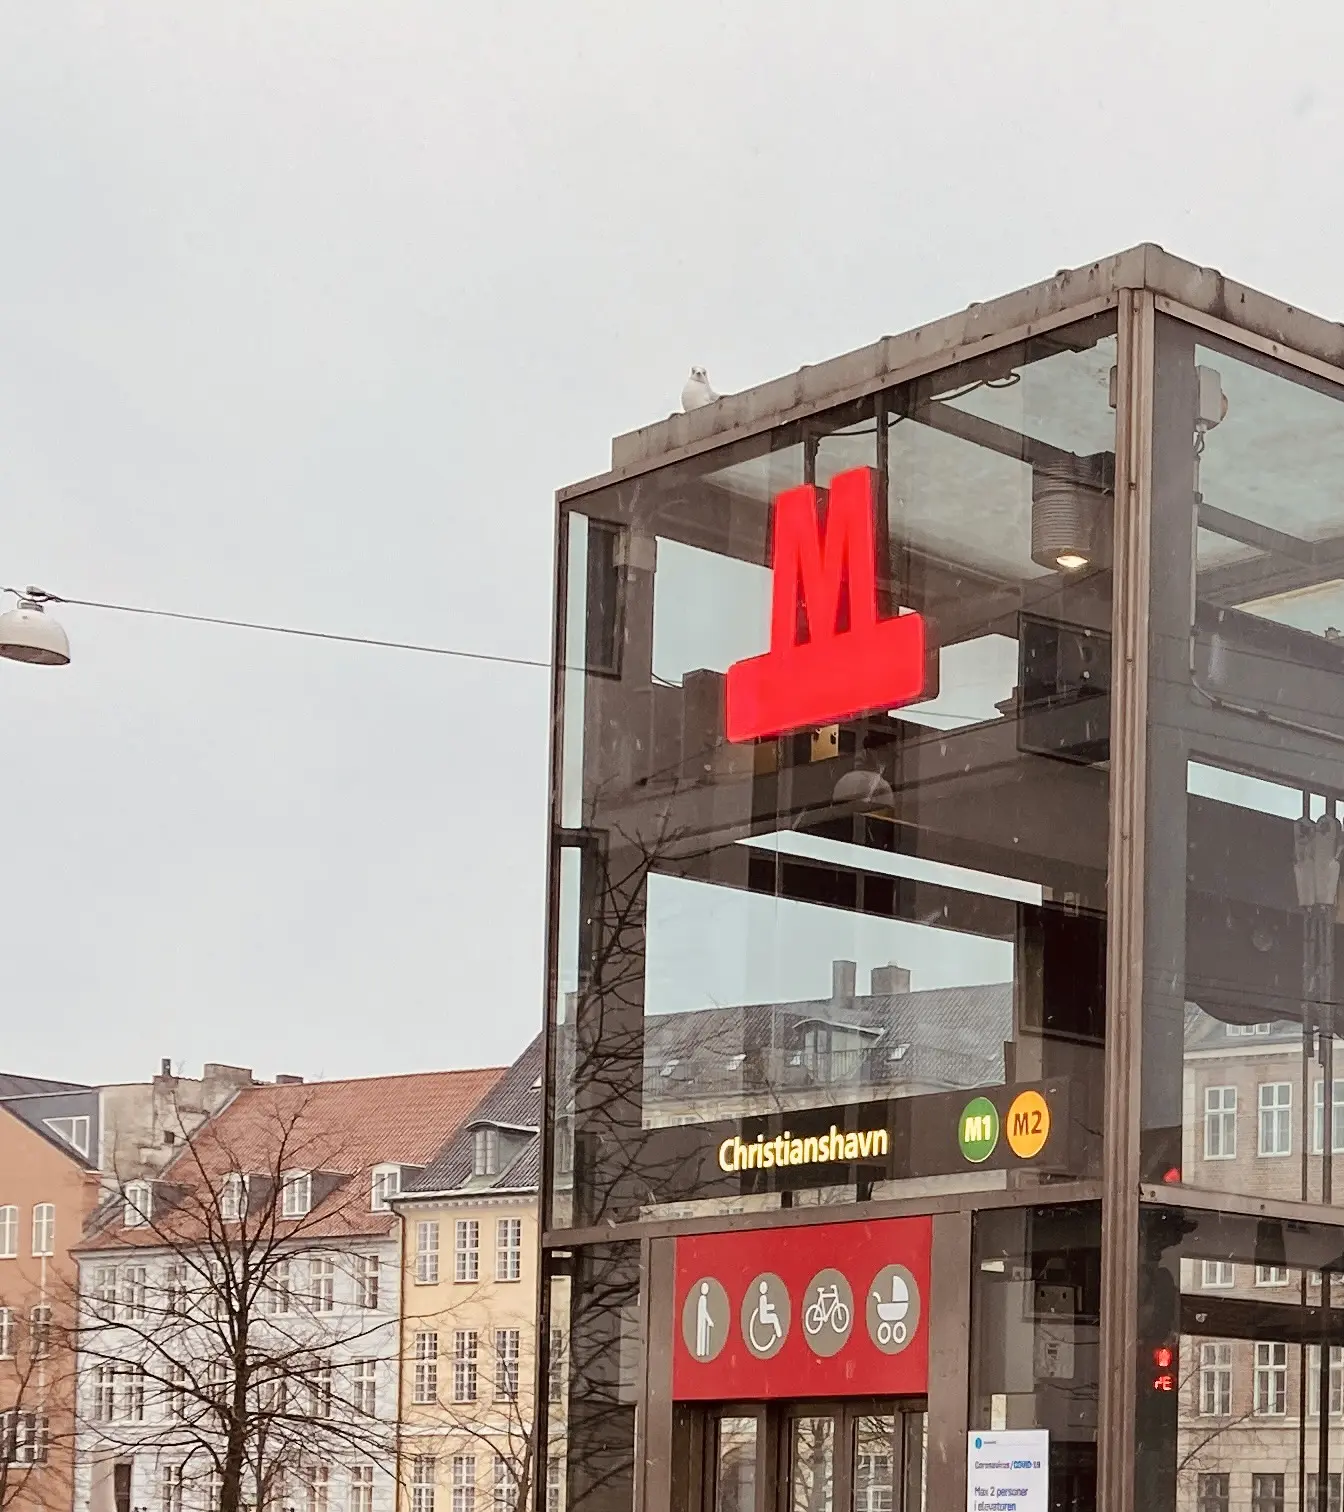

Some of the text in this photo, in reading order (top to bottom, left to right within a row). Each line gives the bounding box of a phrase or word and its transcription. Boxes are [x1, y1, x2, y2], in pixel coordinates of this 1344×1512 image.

[718, 1110, 1043, 1172] Christianshavn M1 M2
[990, 1487, 995, 1496] 2
